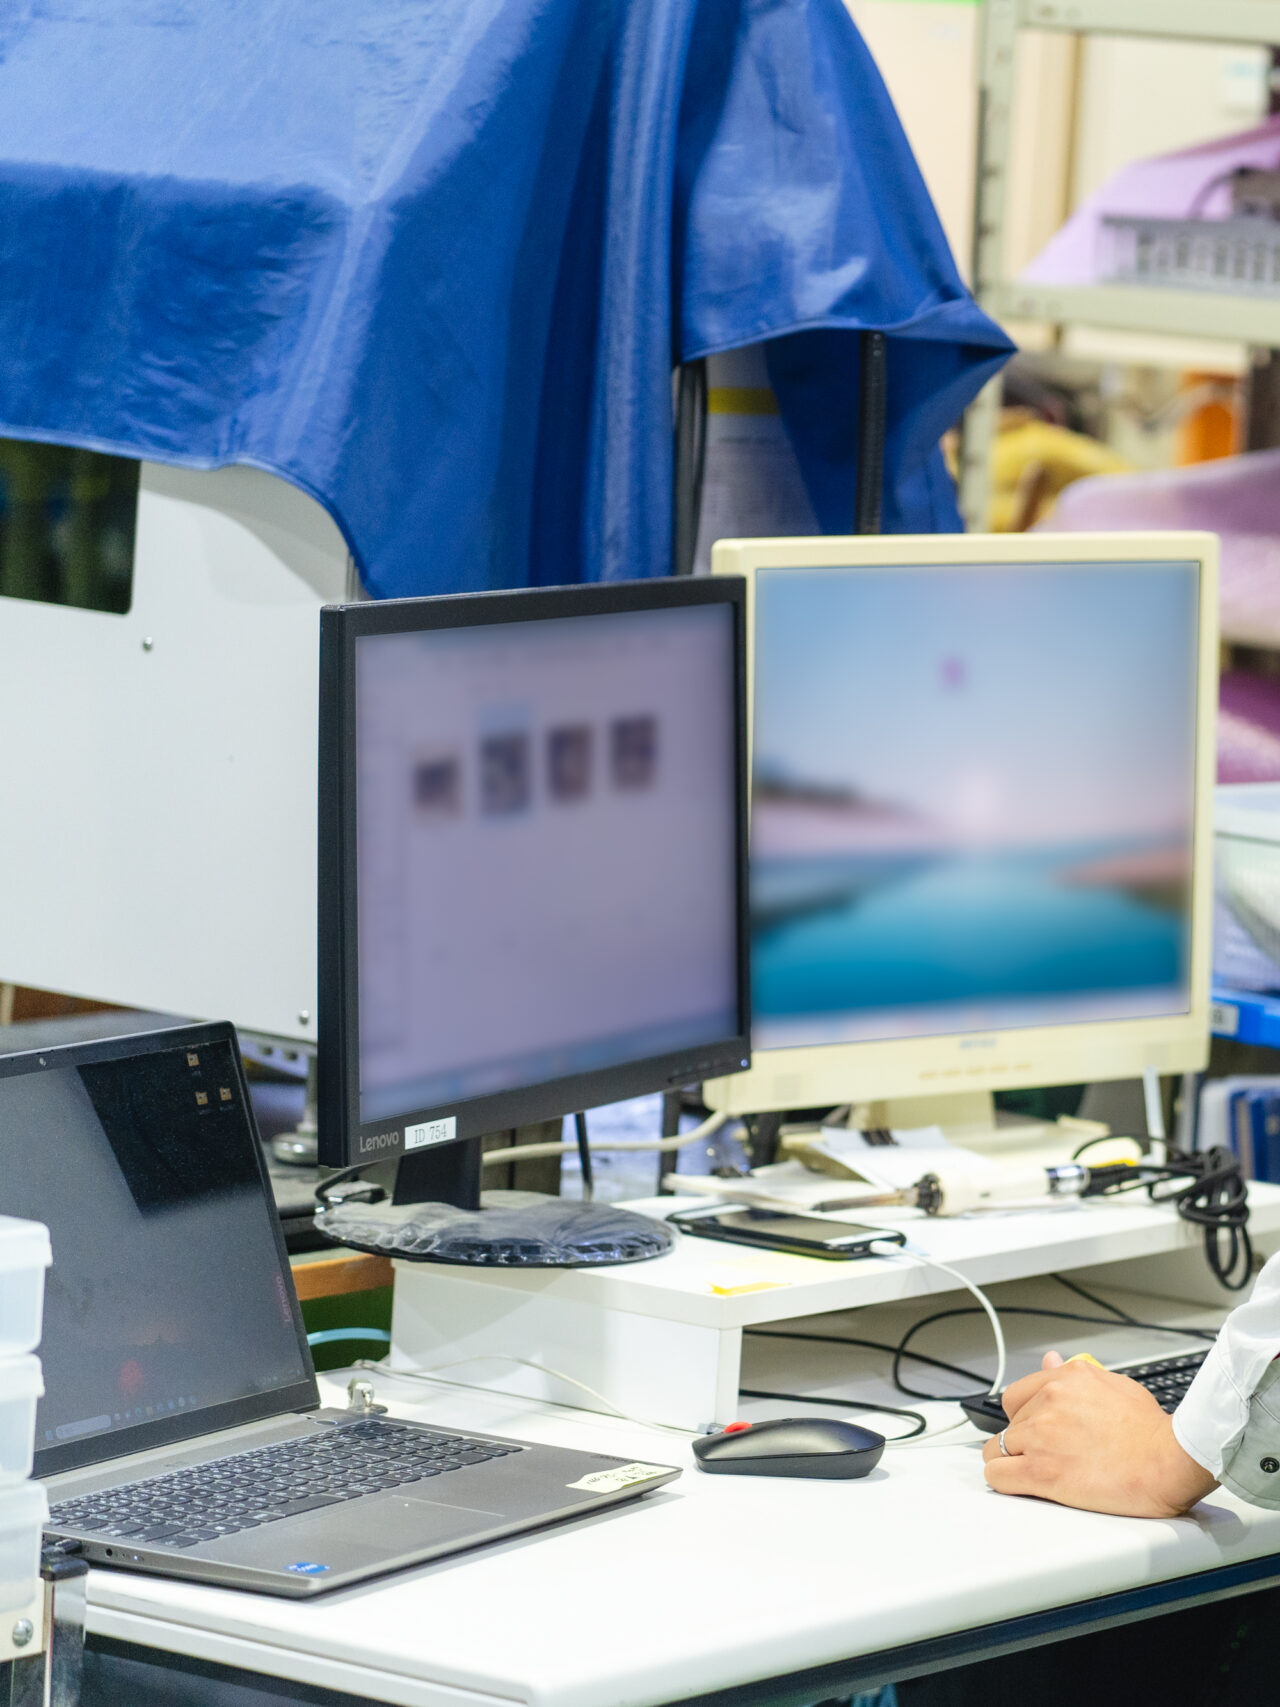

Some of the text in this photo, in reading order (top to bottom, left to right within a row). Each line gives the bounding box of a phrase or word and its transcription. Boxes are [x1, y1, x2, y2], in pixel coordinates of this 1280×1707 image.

[360, 1131, 399, 1153] Lenovo
[414, 1123, 447, 1144] ID 754
